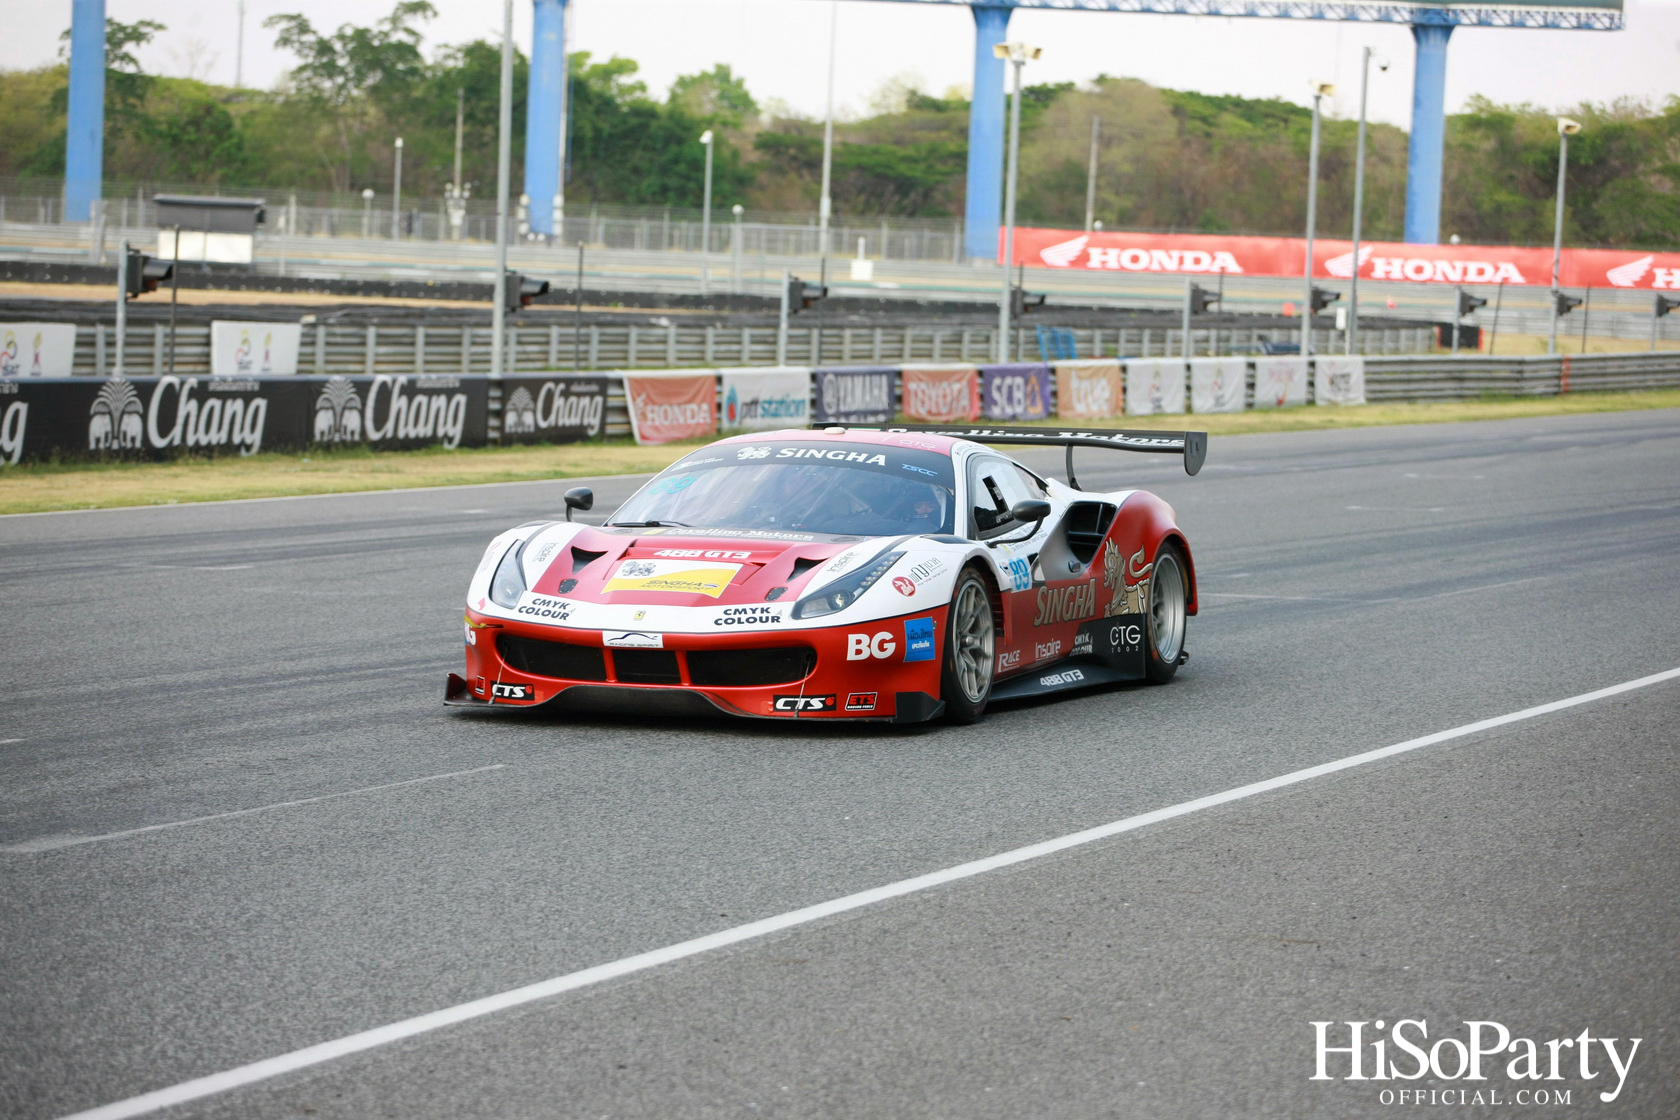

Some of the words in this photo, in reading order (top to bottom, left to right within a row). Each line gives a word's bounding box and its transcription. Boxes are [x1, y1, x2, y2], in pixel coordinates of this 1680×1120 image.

[1087, 247, 1244, 274] HONDA
[1371, 257, 1526, 284] HONDA
[908, 380, 970, 415] TOYOTA
[991, 376, 1025, 414] SCB
[147, 375, 268, 457] Chang
[364, 374, 467, 450] Chang
[536, 381, 603, 437] Chang
[645, 402, 712, 427] HONDA
[776, 448, 887, 467] SINGHA
[653, 549, 704, 558] 488
[704, 550, 752, 559] GT3
[531, 598, 570, 610] CMYK
[723, 606, 771, 616] CMYK
[1033, 577, 1096, 627] SINGHA
[517, 606, 570, 620] COLOUR
[714, 615, 782, 626] COLOUR
[1110, 624, 1141, 646] CTG
[847, 631, 896, 661] BG
[1035, 638, 1061, 659] Inspire
[1040, 673, 1065, 687] 488
[1061, 669, 1084, 683] GT3
[492, 684, 525, 698] CTS
[850, 695, 875, 705] ETS
[776, 697, 827, 710] CTS
